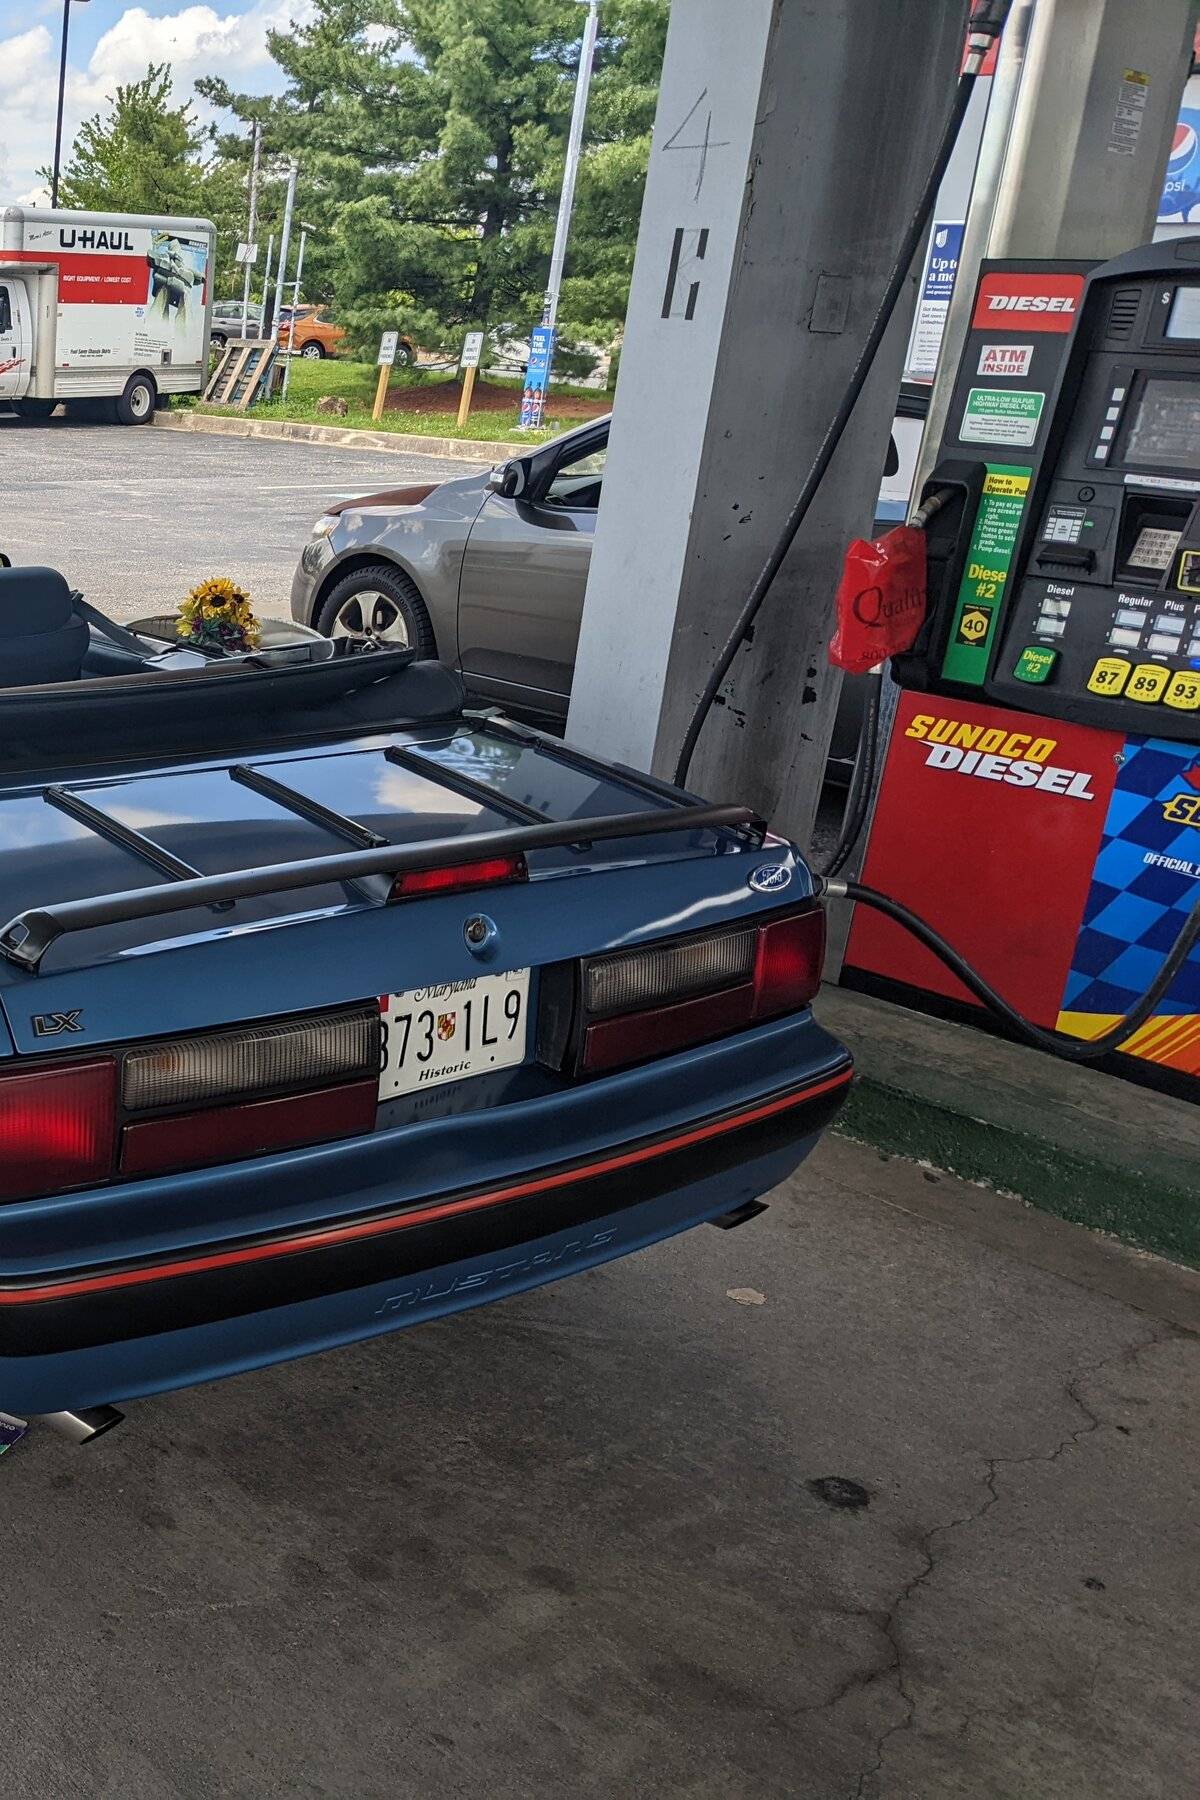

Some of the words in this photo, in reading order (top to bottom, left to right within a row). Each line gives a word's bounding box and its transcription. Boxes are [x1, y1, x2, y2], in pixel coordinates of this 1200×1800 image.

[662, 87, 731, 203] 4
[59, 228, 134, 250] U-HAUL
[932, 257, 948, 270] Up
[929, 273, 936, 282] a
[985, 295, 1076, 313] DIESEL
[1161, 292, 1171, 304] $
[984, 349, 1027, 363] ATM
[982, 363, 1025, 374] INSIDE
[999, 402, 1020, 410] DIESEL
[1010, 396, 1035, 404] SULFUR
[988, 476, 1005, 484] How
[986, 485, 1013, 495] Operate
[982, 525, 997, 533] Press
[984, 519, 1005, 527] Remove
[977, 545, 993, 553] Pump
[968, 564, 1007, 582] Diese
[976, 583, 996, 598] #2
[1047, 584, 1074, 596] Diesel
[853, 586, 923, 628] Qualit
[1118, 594, 1154, 608] Regular
[1164, 600, 1185, 612] Plus
[964, 619, 985, 633] 40
[1023, 650, 1052, 663] Diesel
[1026, 663, 1041, 673] #2
[1095, 670, 1120, 685] 87
[1133, 676, 1158, 692] 89
[1173, 683, 1197, 699] 93
[904, 714, 1058, 763] SUNOCO
[917, 740, 1096, 801] DIESEL
[1143, 852, 1193, 874] OFFICIAL
[414, 976, 478, 1003] Maryland
[31, 1009, 85, 1037] LX
[463, 989, 521, 1052] 1L9
[418, 1060, 472, 1082] Historic
[375, 1227, 618, 1314] MUSTANG
